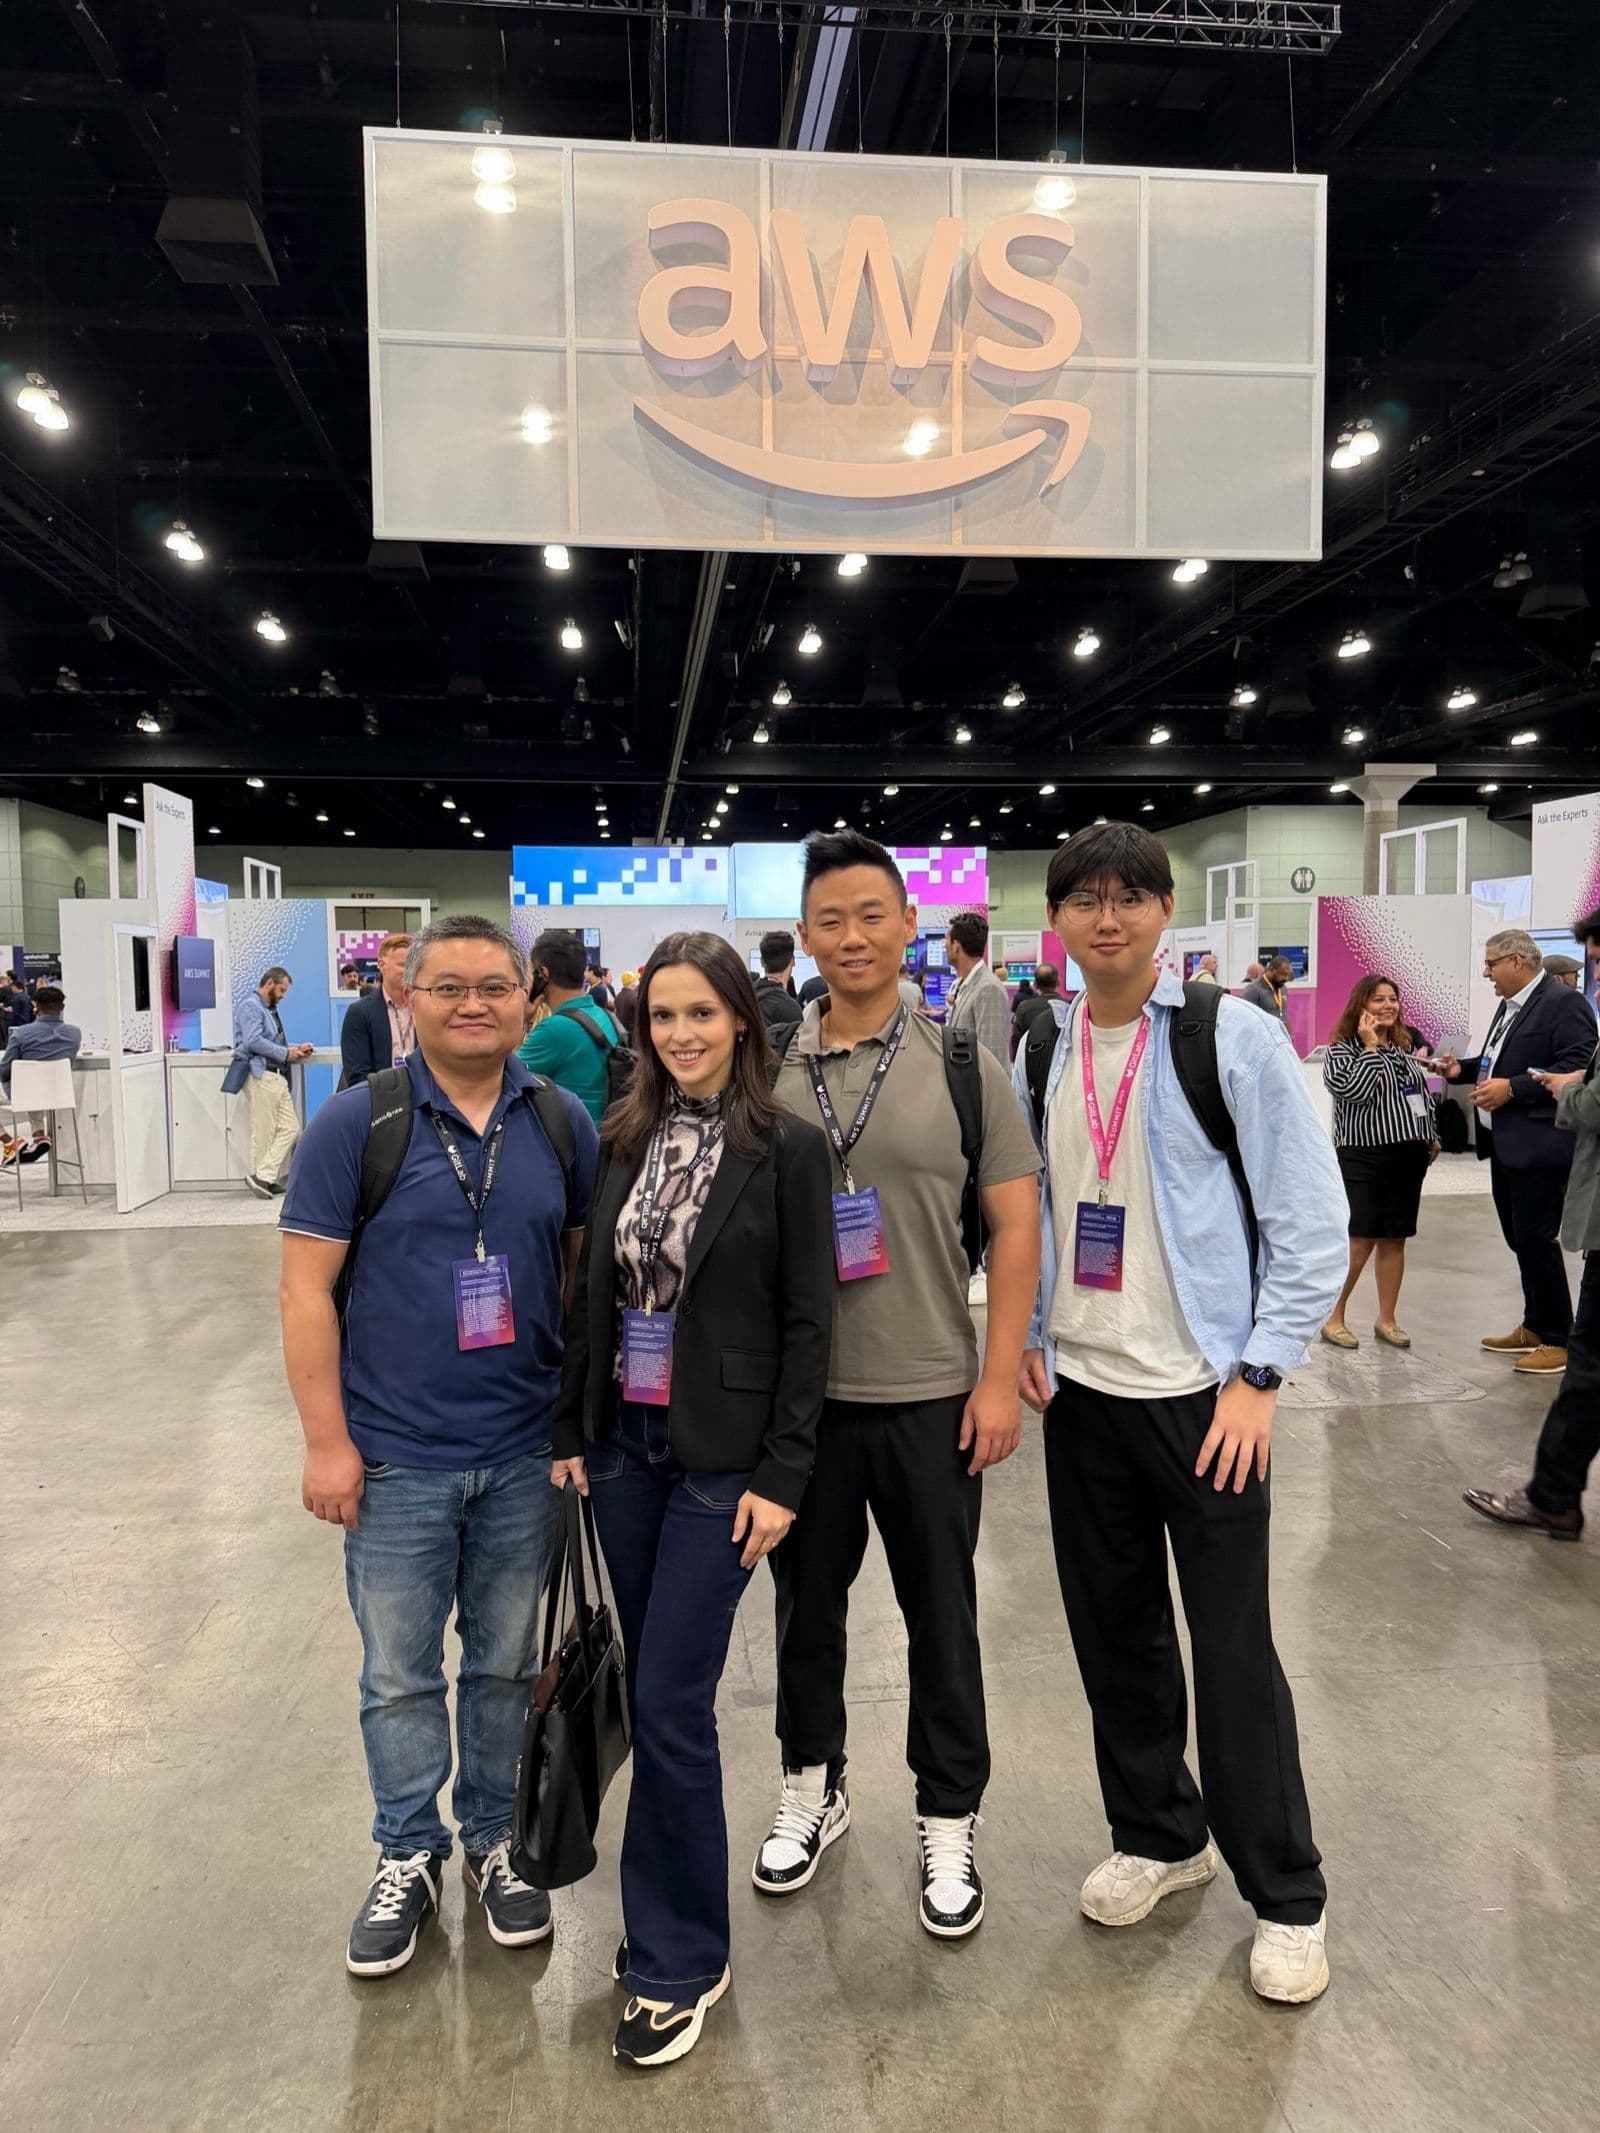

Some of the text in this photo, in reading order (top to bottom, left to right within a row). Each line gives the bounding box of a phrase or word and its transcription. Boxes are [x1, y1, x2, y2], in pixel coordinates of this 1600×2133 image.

[638, 198, 1083, 382] aws
[1536, 809, 1589, 825] Ask the Experts
[184, 968, 194, 979] AWS
[882, 1042, 897, 1065] GitLab
[1128, 1041, 1143, 1069] GitLab
[818, 1093, 832, 1118] GitLab
[1087, 1102, 1099, 1130] GitLab
[712, 1119, 727, 1139] 2026
[849, 1097, 872, 1144] AWS SUMMIT
[1109, 1106, 1122, 1138] SUMMIT
[688, 1147, 709, 1172] GitLab
[1105, 1138, 1114, 1157] AWS
[451, 1153, 468, 1182] GitLab
[485, 1158, 496, 1190] SUMMIT
[641, 1200, 652, 1230] GitLab
[649, 1206, 669, 1260] AWS SUMMIT
